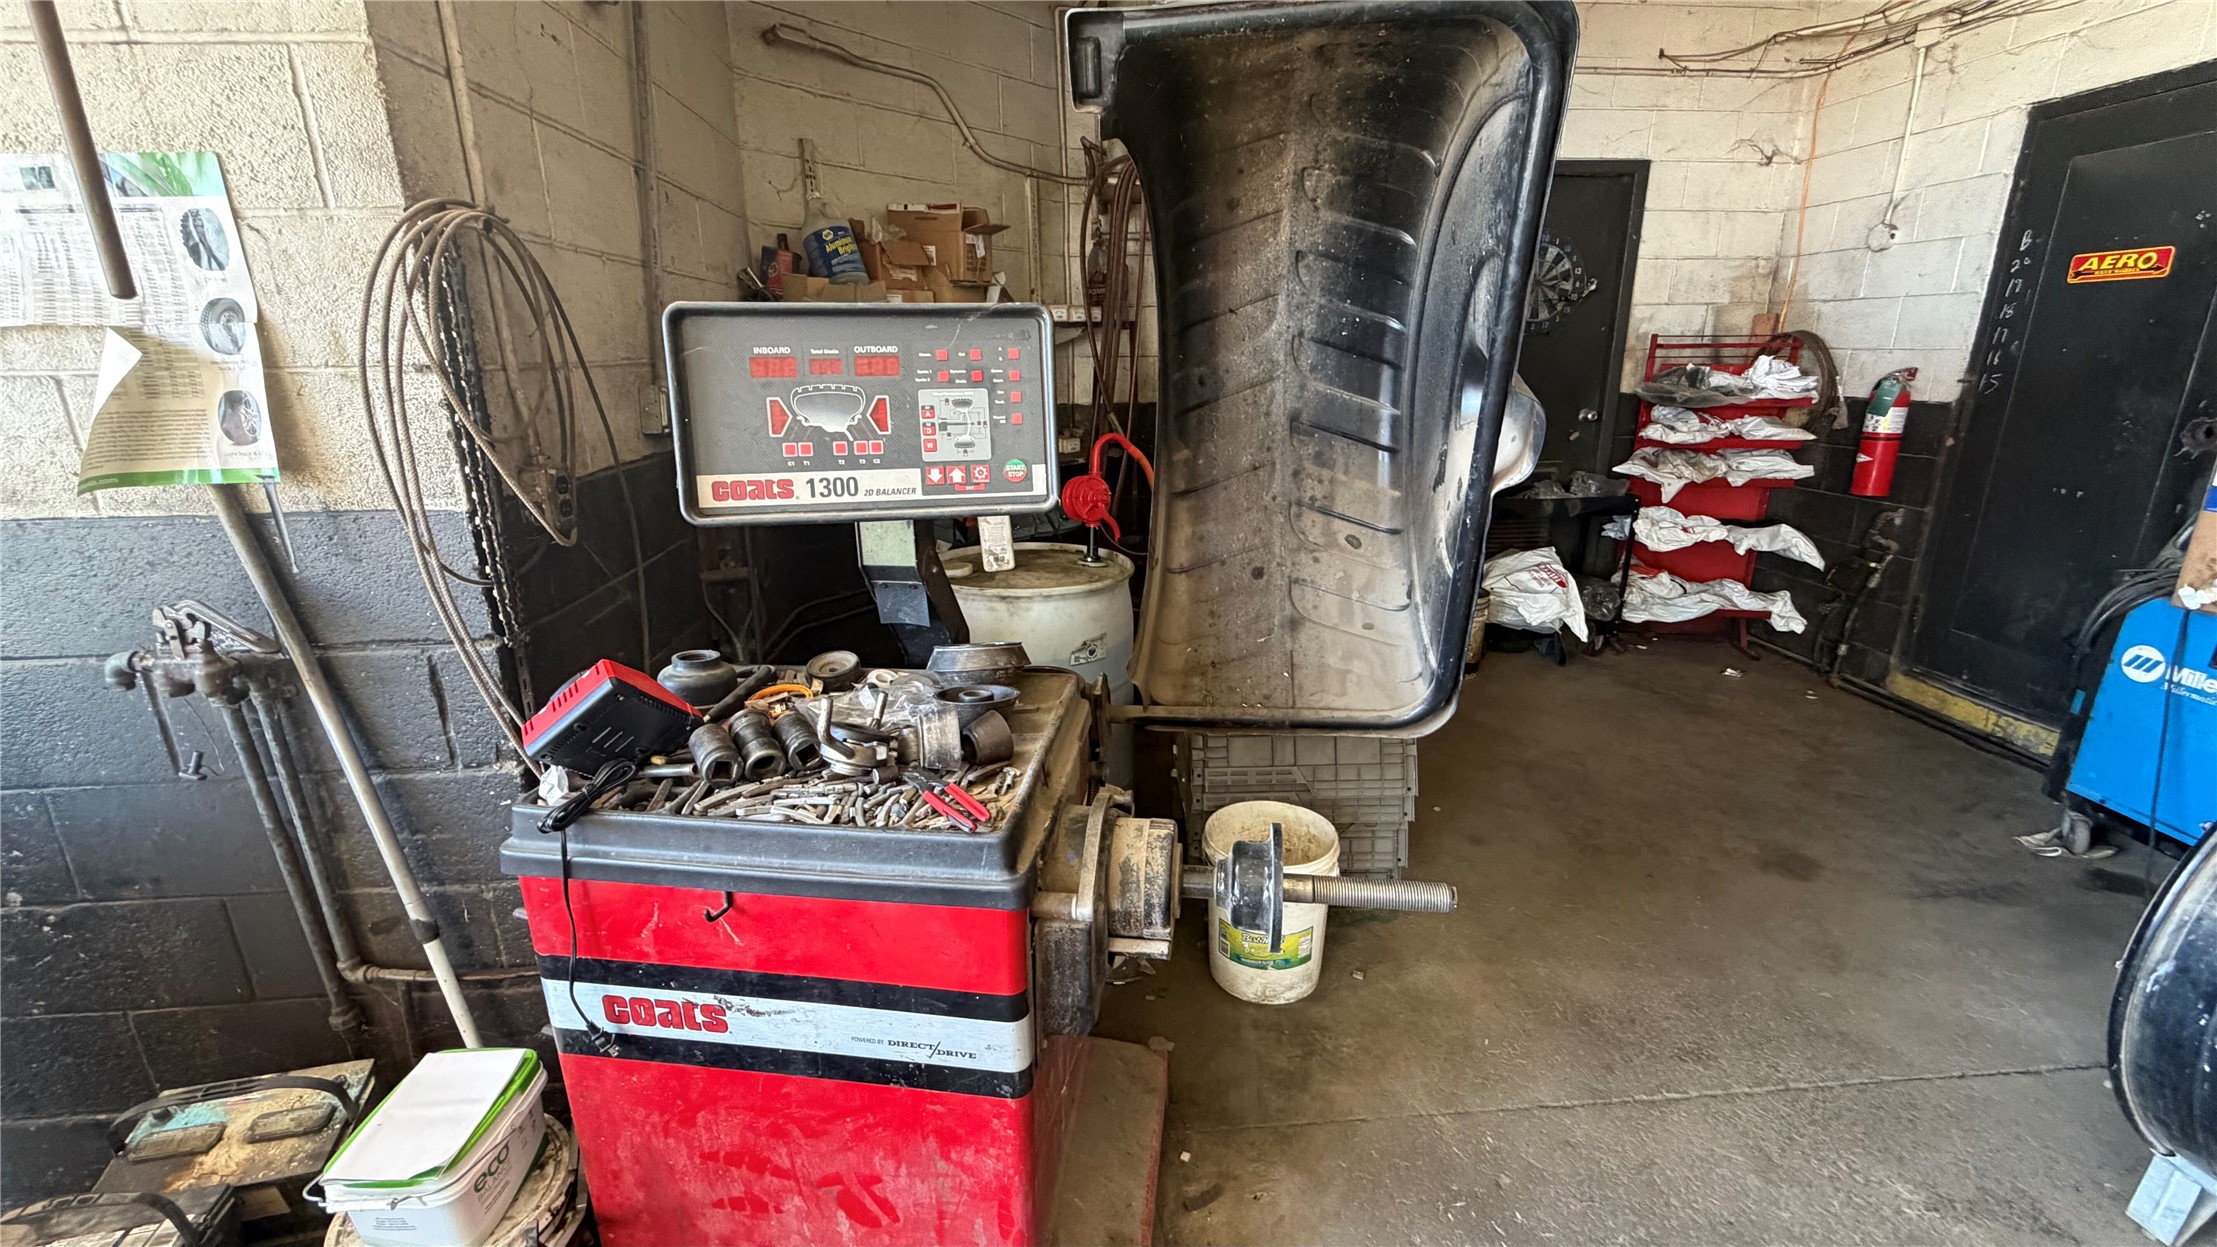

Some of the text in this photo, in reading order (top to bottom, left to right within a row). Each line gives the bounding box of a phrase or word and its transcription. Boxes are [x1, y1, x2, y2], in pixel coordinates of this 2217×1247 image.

[2078, 252, 2158, 271] AERO
[854, 346, 898, 354] OUTBOARD
[806, 476, 859, 498] 1300
[875, 487, 917, 496] BALANCER
[851, 1036, 876, 1044] POWERED
[473, 1140, 509, 1193] eco
